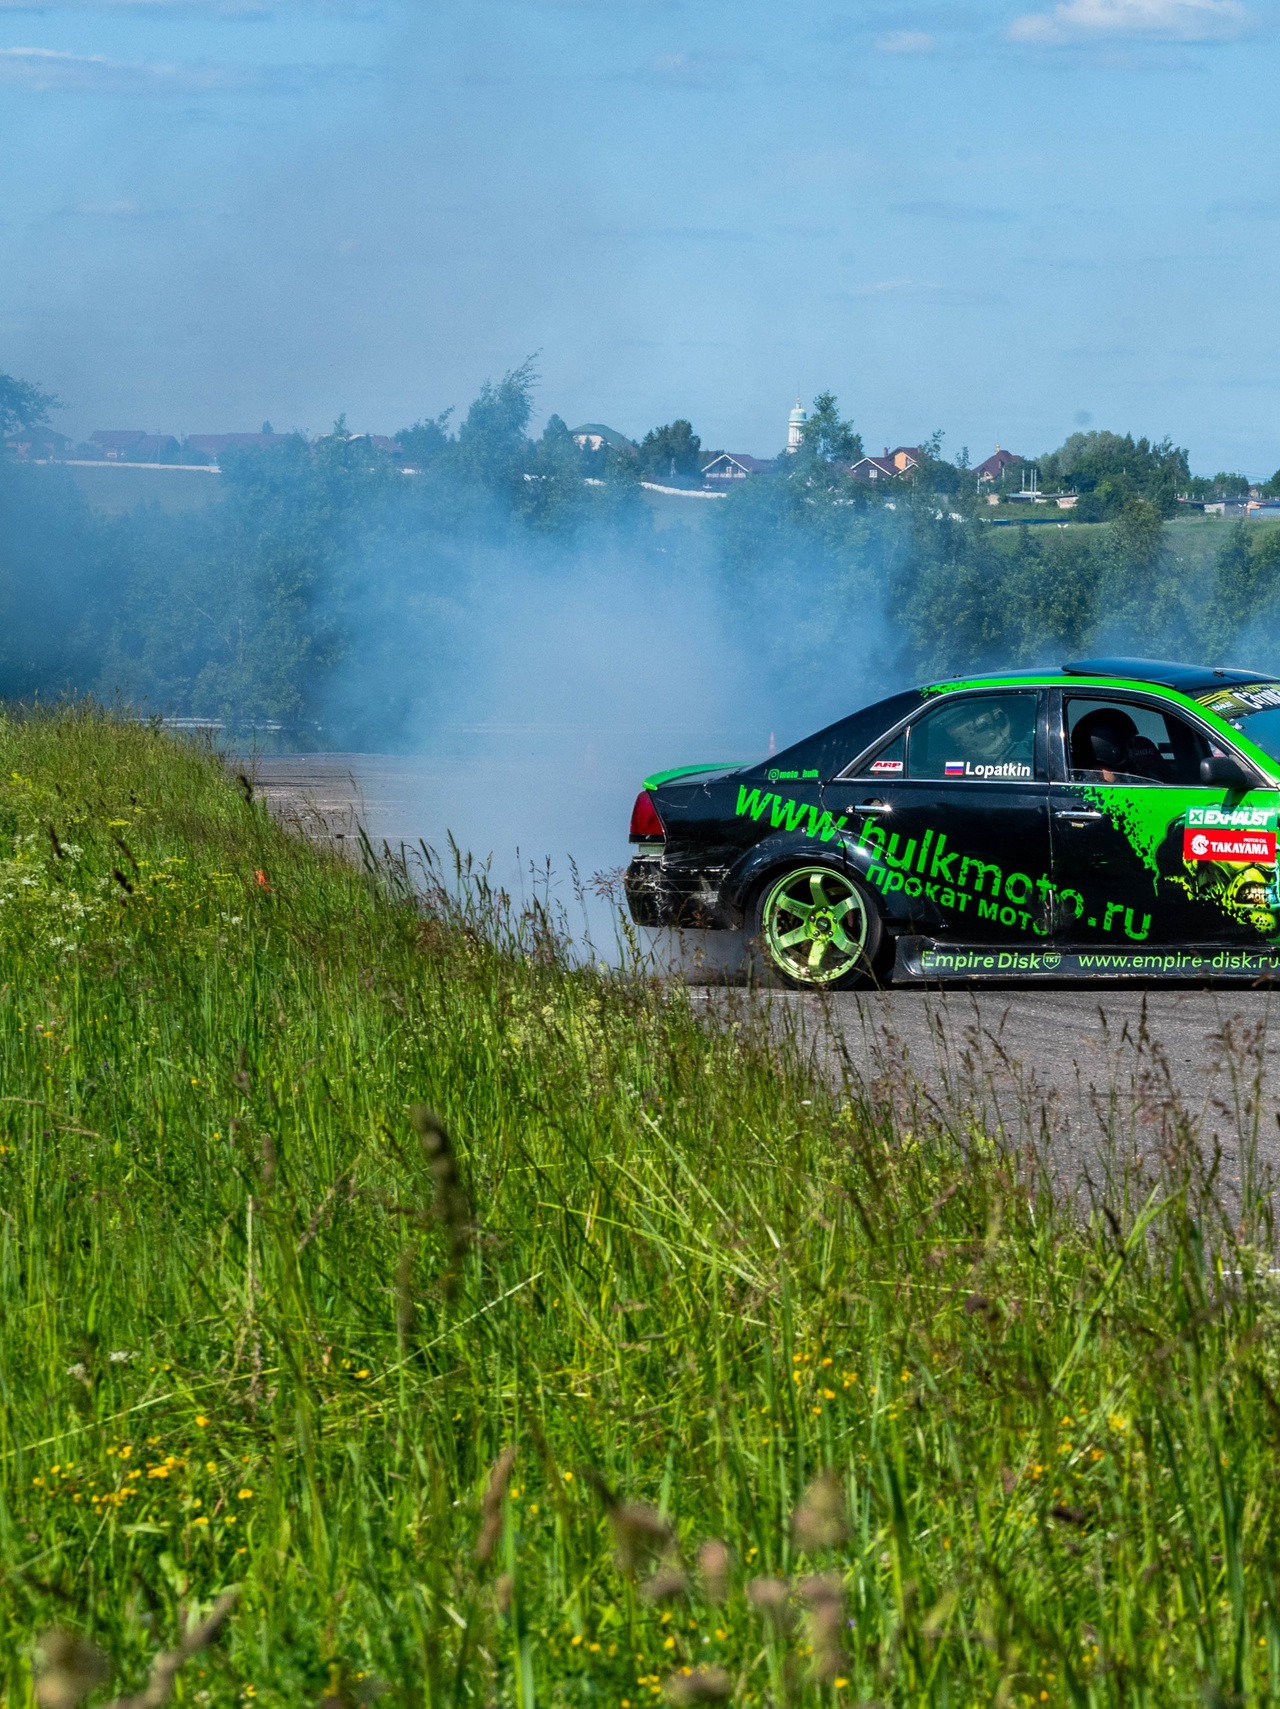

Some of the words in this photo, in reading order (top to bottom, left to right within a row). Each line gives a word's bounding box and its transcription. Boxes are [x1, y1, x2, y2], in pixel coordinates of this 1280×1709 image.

[965, 761, 1031, 779] Lopatkin
[1203, 809, 1276, 826] EXHAUST
[1210, 841, 1269, 855] TAKAYAMA
[735, 784, 1152, 942] www.hulkmoto.ru
[866, 864, 972, 912] прокат
[922, 951, 995, 971] Empire
[998, 952, 1041, 969] Disk
[1078, 952, 1279, 972] www.empire-disk.ru
